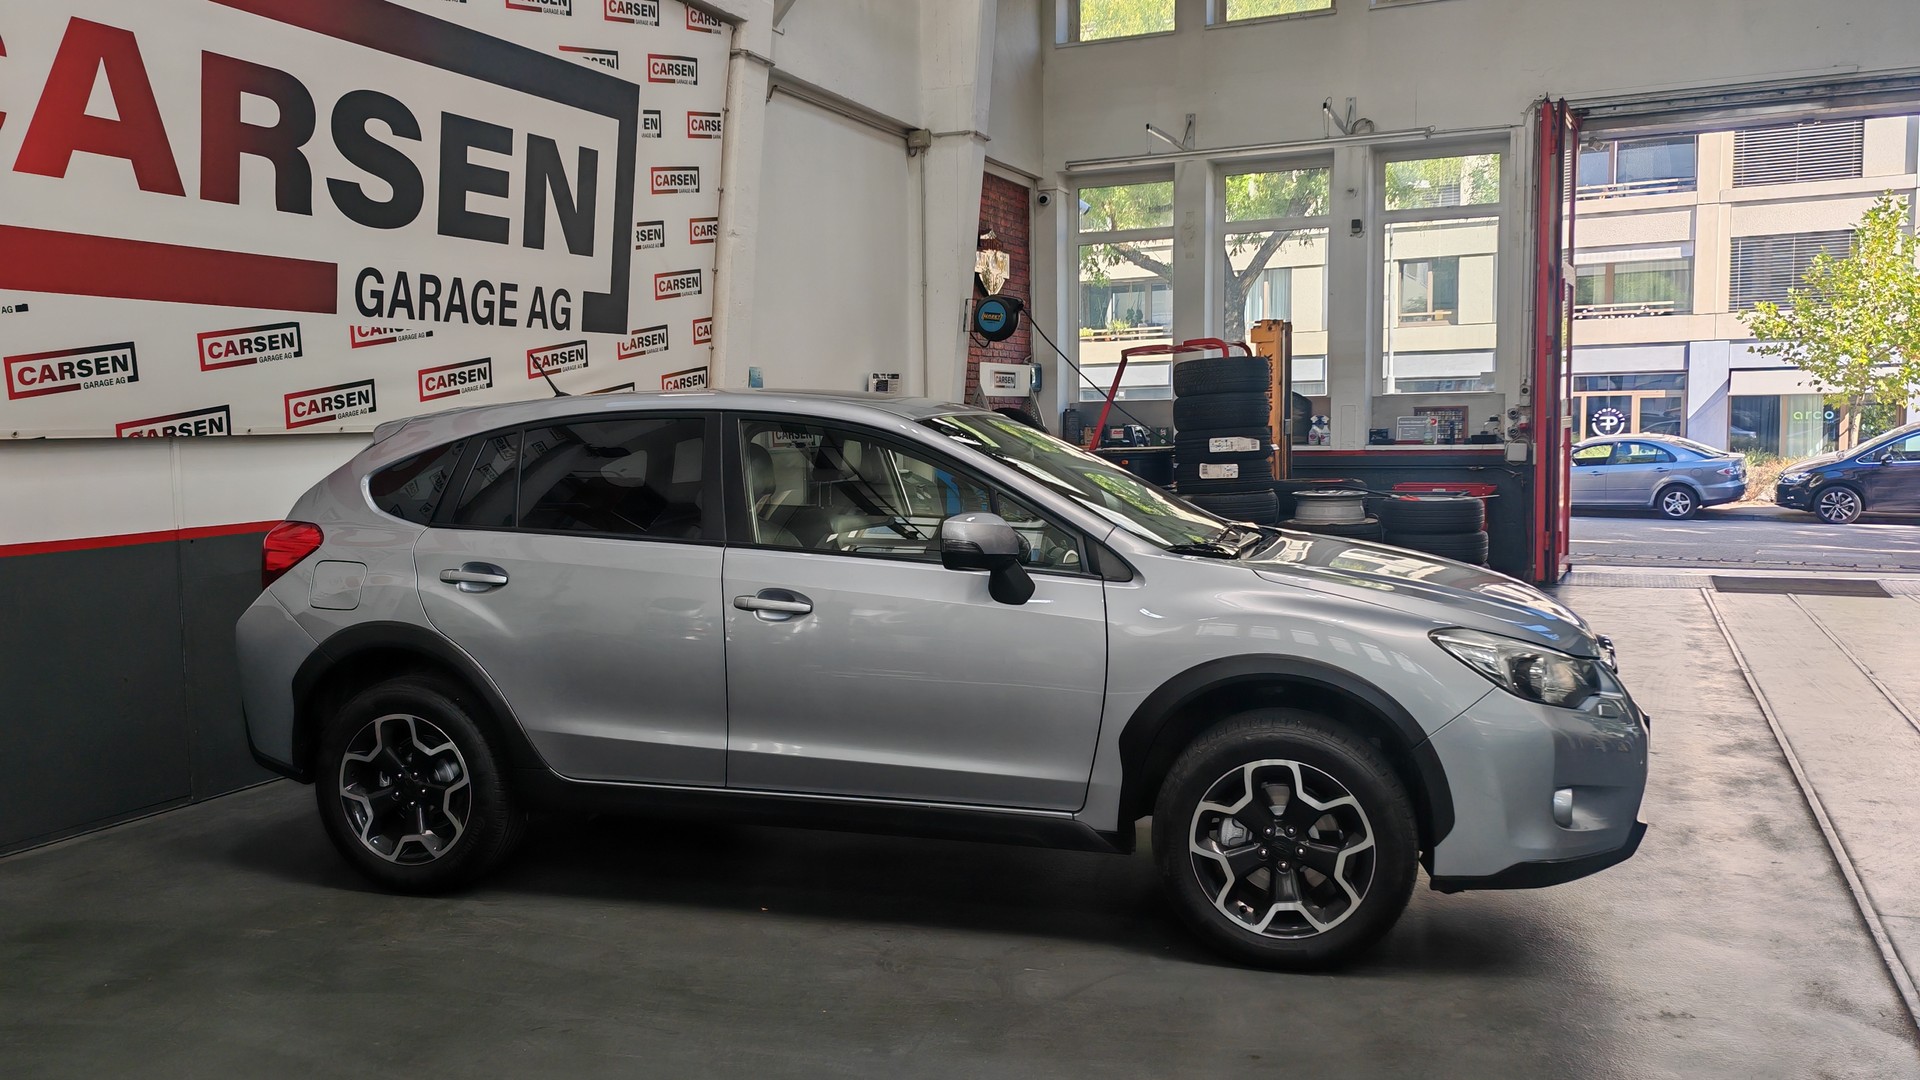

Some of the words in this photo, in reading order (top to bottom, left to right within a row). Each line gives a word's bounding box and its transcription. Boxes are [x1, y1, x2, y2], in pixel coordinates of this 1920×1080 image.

[609, 0, 656, 18] CARSEN
[652, 62, 694, 77] CARSEN
[642, 118, 658, 130] EN
[0, 15, 598, 258] ARSEN
[655, 174, 697, 186] CARSEN
[658, 276, 699, 292] CARSEN
[354, 266, 518, 328] GARAGE
[526, 286, 572, 331] AG
[1, 305, 13, 314] AG
[398, 333, 418, 341] GARAGE
[696, 324, 712, 337] CA
[207, 332, 295, 359] CARSEN
[258, 353, 283, 363] GARAGE
[284, 352, 293, 360] AG
[532, 348, 584, 370] CARSEN
[17, 354, 129, 386] CARSEN
[83, 379, 114, 390] GARAGE
[115, 376, 126, 385] AG
[425, 366, 487, 391] CARSEN
[666, 373, 705, 390] CARSEN
[461, 385, 479, 394] GARAGE
[293, 389, 370, 418] CARSEN
[337, 410, 359, 420] GARAGE
[360, 407, 367, 415] AG
[1793, 411, 1834, 420] arco
